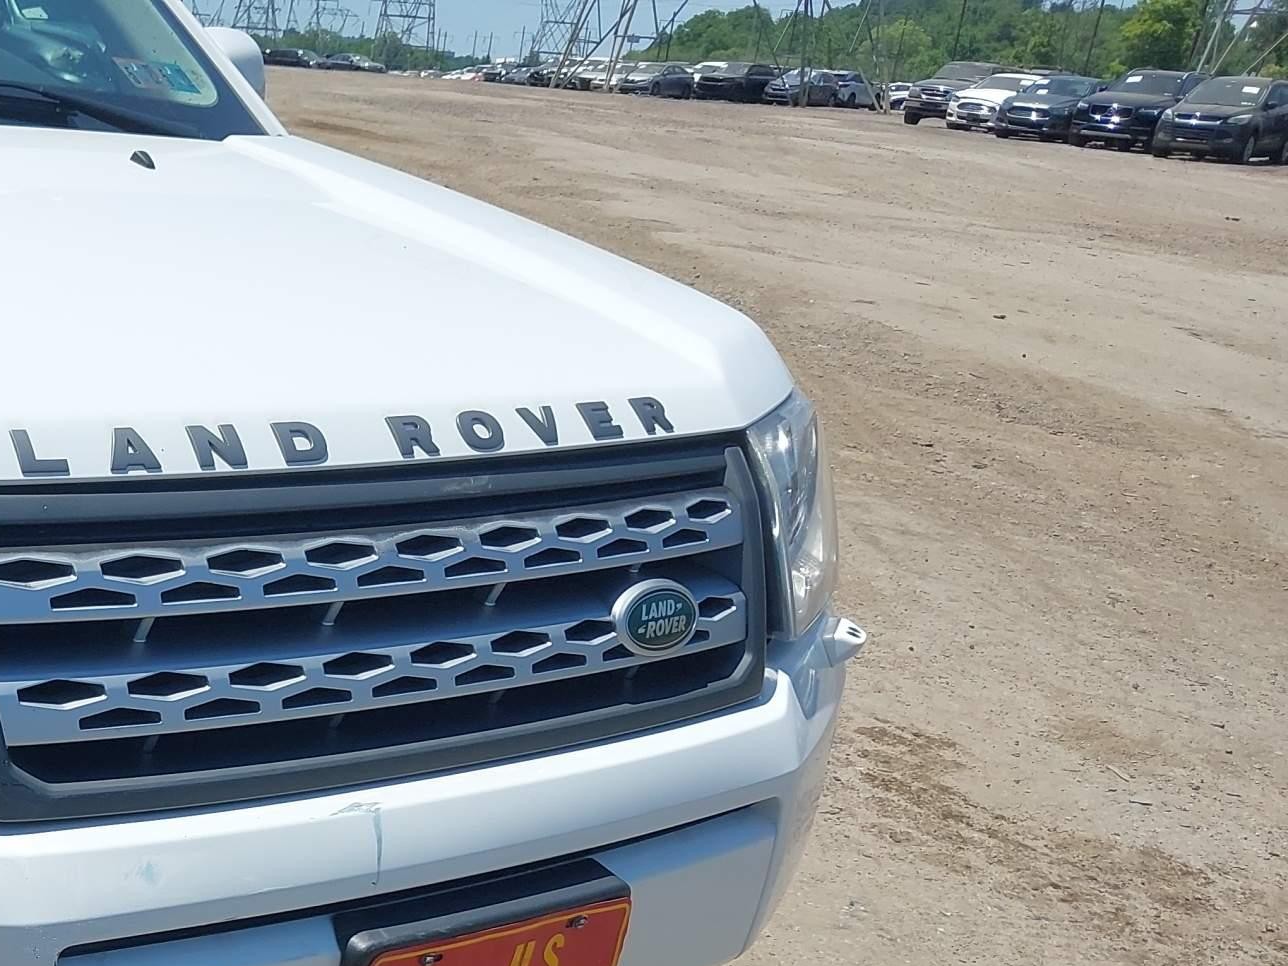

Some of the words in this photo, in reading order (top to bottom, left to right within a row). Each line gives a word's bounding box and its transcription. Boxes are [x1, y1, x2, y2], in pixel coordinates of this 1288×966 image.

[9, 420, 329, 477] LAND
[384, 396, 675, 459] ROVER
[641, 599, 676, 621] LAND
[646, 614, 687, 639] ROVER
